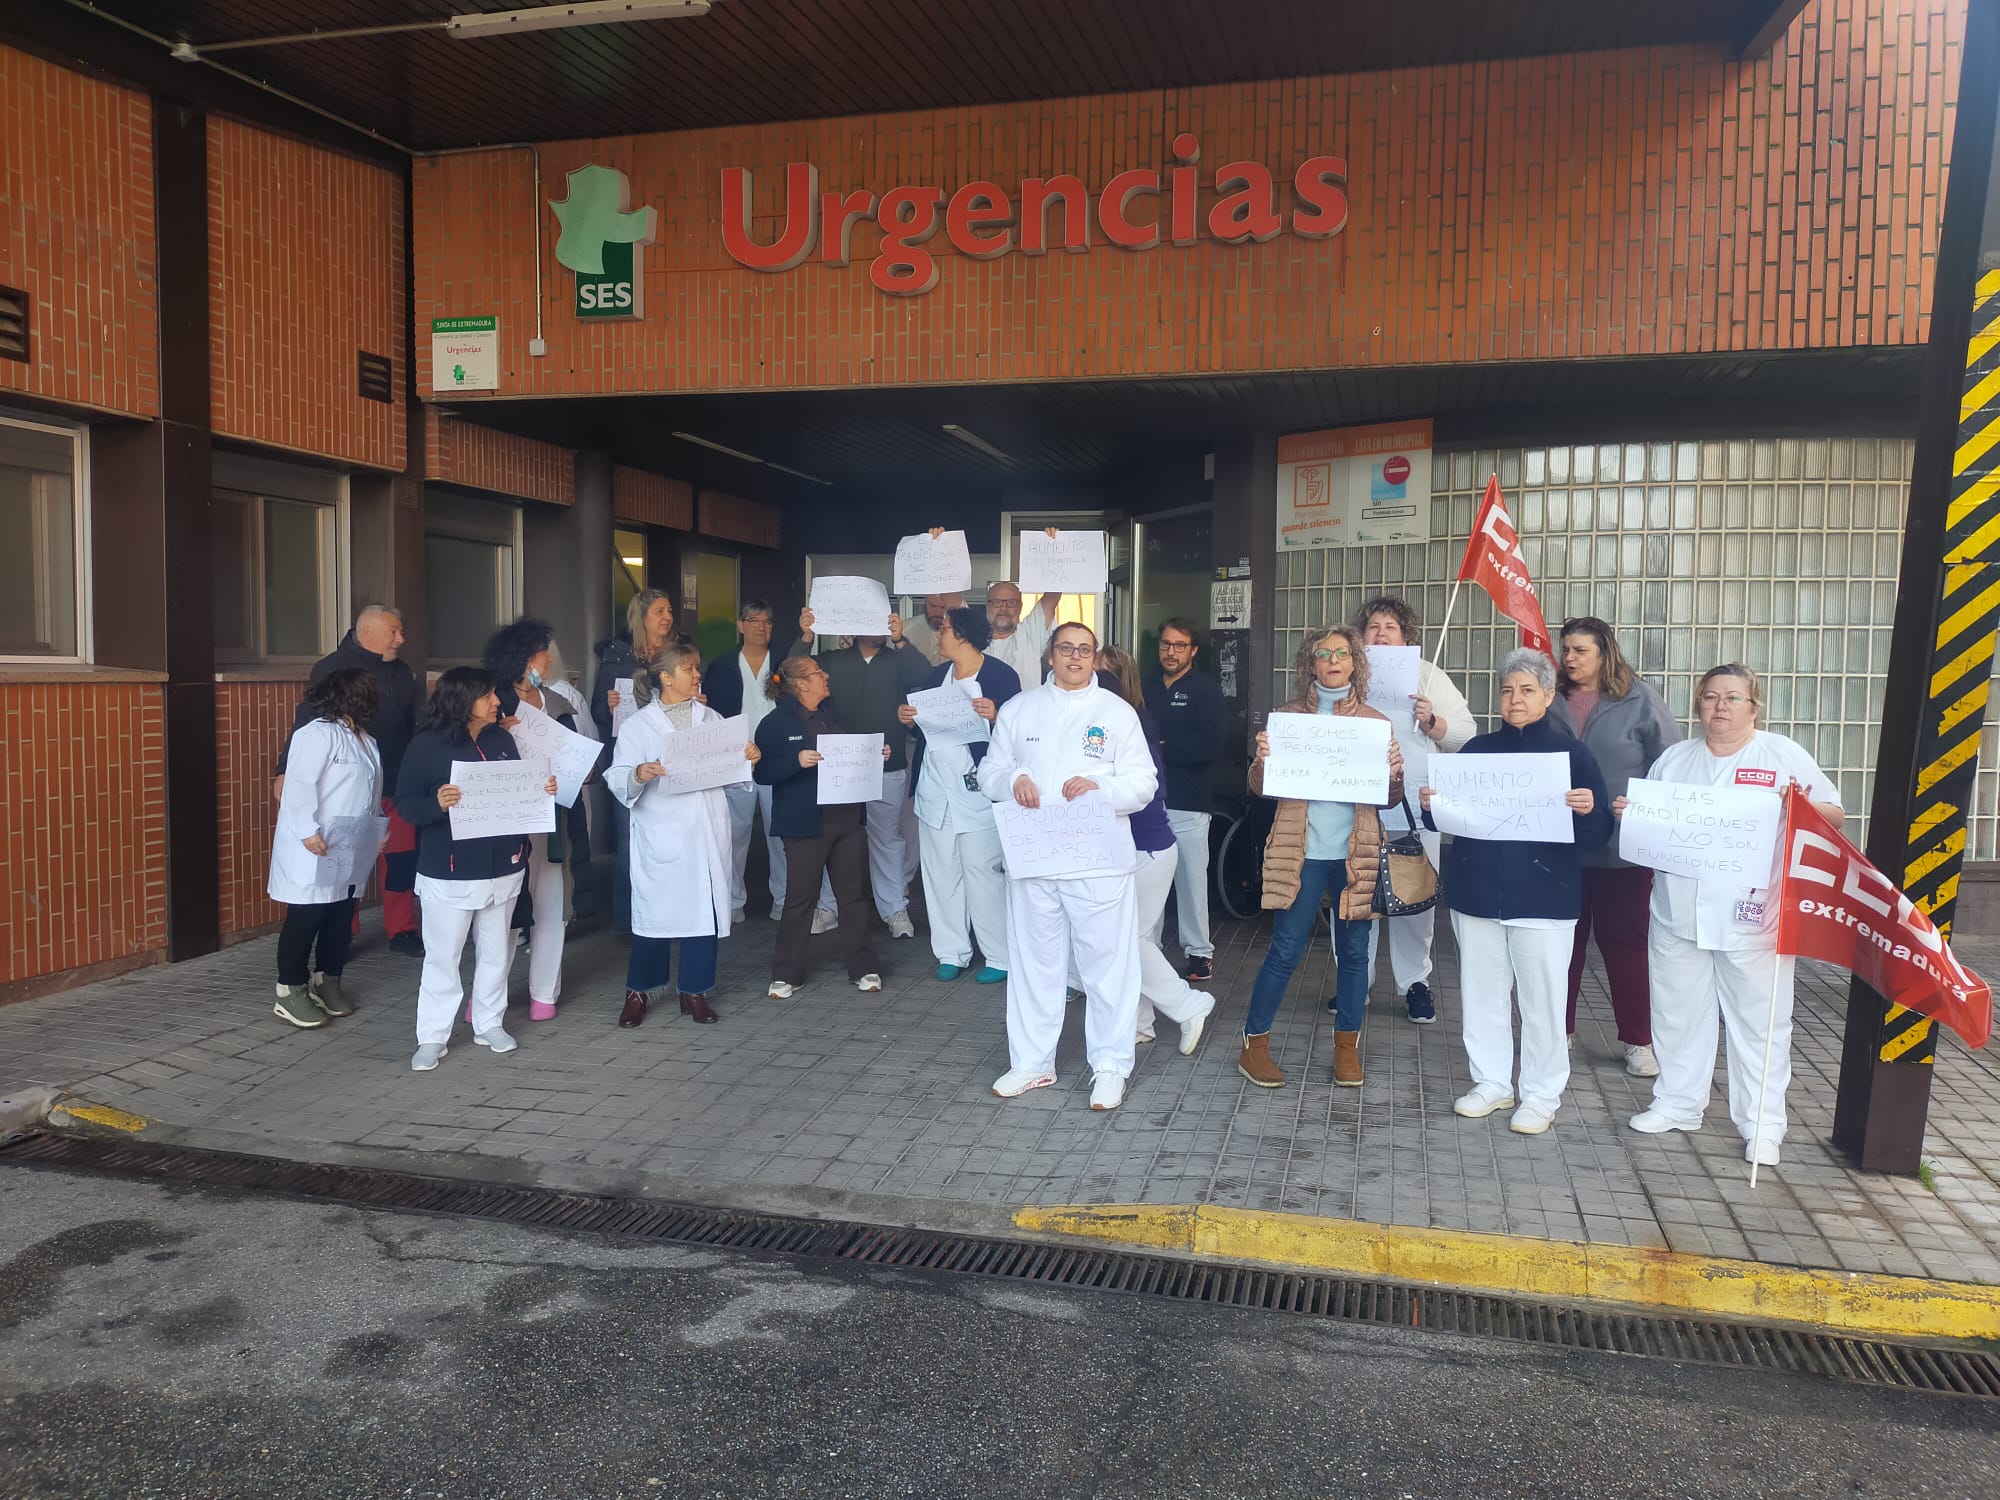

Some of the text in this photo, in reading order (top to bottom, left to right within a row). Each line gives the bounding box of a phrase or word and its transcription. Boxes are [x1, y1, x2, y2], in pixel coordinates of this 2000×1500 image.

[720, 133, 1348, 295] Urgencias
[579, 281, 632, 310] SES
[436, 321, 451, 329] JUNTA
[457, 319, 492, 328] EXTREMADURA
[446, 346, 482, 355] Urgencias
[1393, 432, 1426, 449] HOSPITAL
[1281, 520, 1308, 535] guarde
[1028, 538, 1087, 554] AUMENTO
[909, 562, 926, 573] NO
[1024, 556, 1087, 568] DE PLANTILLA
[903, 573, 962, 584] FUNCIONES
[813, 583, 873, 592] AUMENTO DE
[520, 710, 548, 737] NO
[1273, 721, 1359, 741] NO SOMOS
[666, 726, 730, 757] AUMENTO
[1282, 741, 1352, 755] PERSONAL
[1267, 761, 1311, 778] FUERZA
[1327, 755, 1349, 767] DE
[456, 770, 485, 783] LAS
[490, 771, 534, 781] MEDIDAS
[1330, 777, 1384, 789] ARRASTRE
[1434, 768, 1534, 792] AUMENTO
[1440, 794, 1558, 808] DE PLANTILLA
[1672, 787, 1714, 805] LAS
[1000, 800, 1113, 831] PROTOCOLO
[1628, 801, 1759, 832] TRADICIONES
[1009, 823, 1104, 847] DE TRIAJE
[1668, 827, 1759, 851] NO SON
[1022, 841, 1093, 863] CLARO
[1636, 847, 1744, 872] FUNCIONES
[1799, 898, 1967, 1003] extremadura
